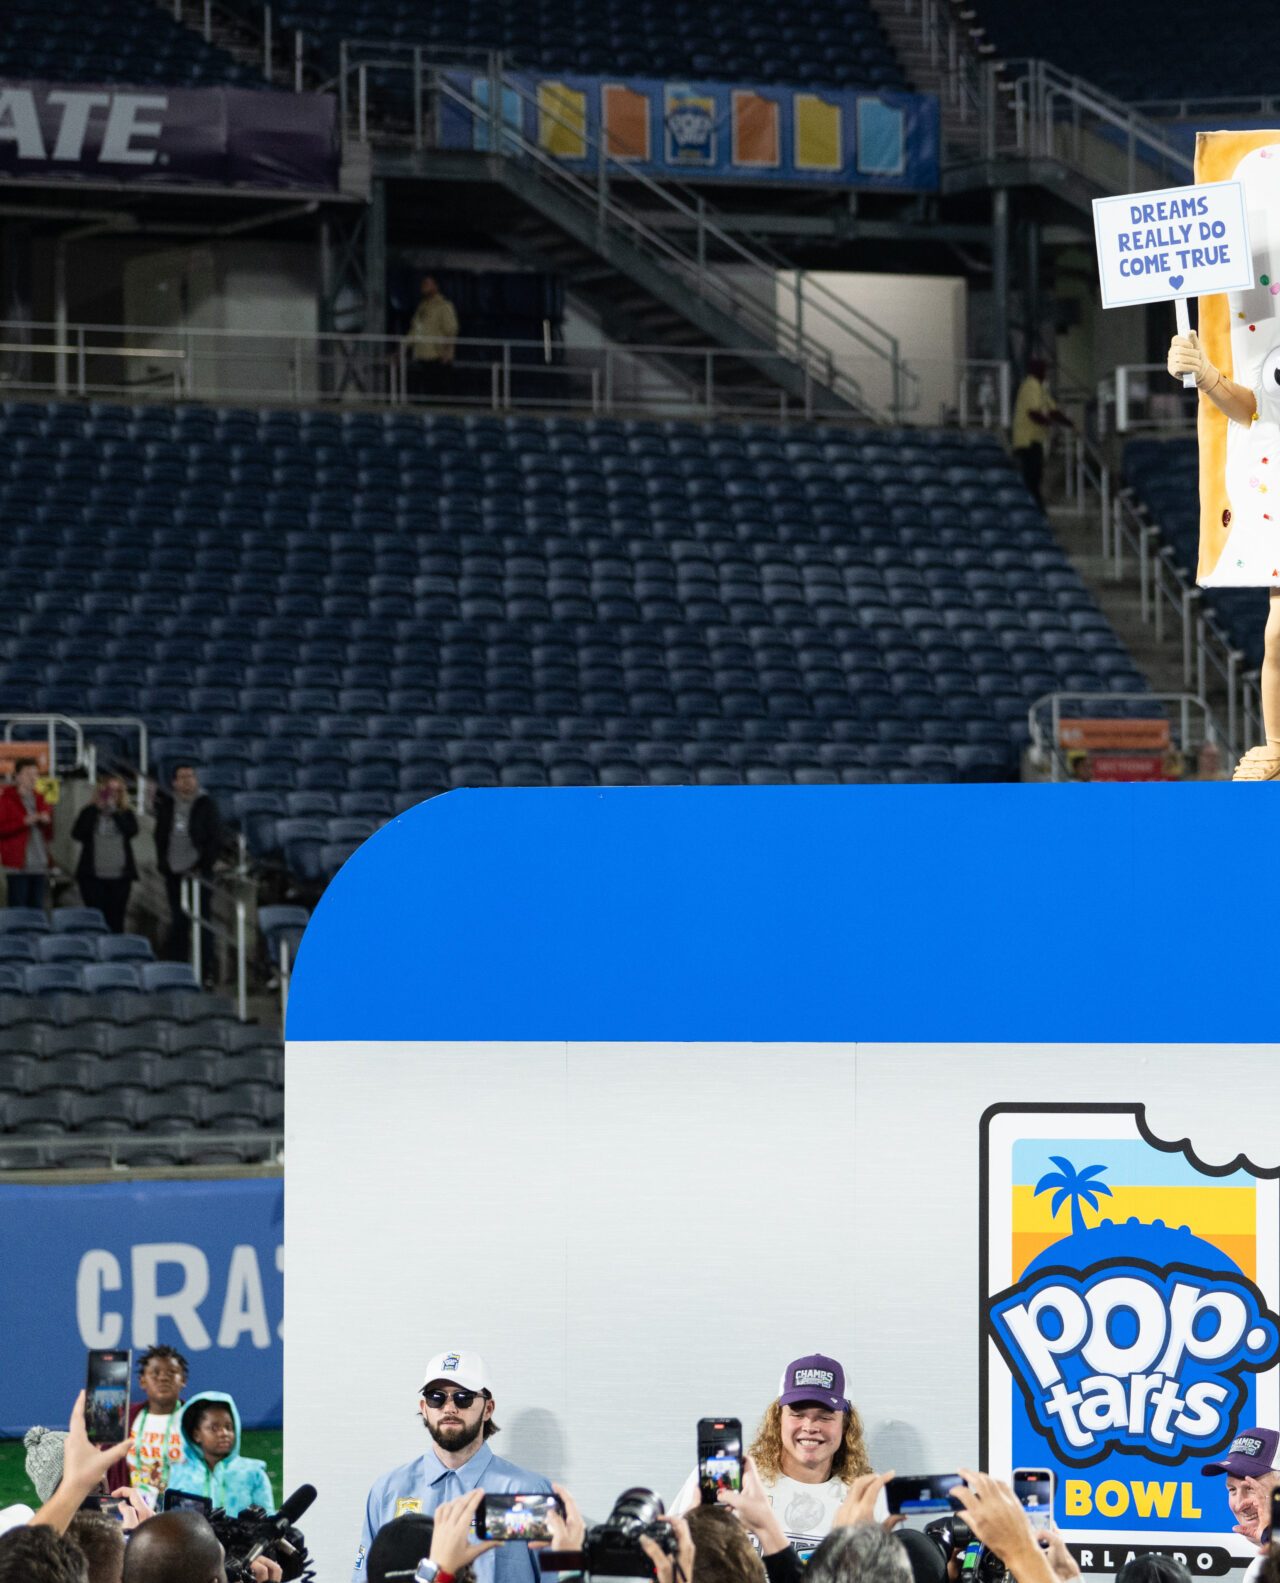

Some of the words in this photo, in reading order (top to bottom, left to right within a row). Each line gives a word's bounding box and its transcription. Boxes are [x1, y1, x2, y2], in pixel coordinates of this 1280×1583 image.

[1130, 196, 1209, 225] DREAMS
[1118, 223, 1193, 252] REALLY
[1199, 220, 1226, 241] DO
[1120, 253, 1171, 277] COME
[1175, 244, 1231, 269] TRUE
[76, 1242, 283, 1351] CRA
[795, 1369, 834, 1382] CHAMPS
[128, 1446, 181, 1459] MARO
[1065, 1479, 1202, 1519] BOWL
